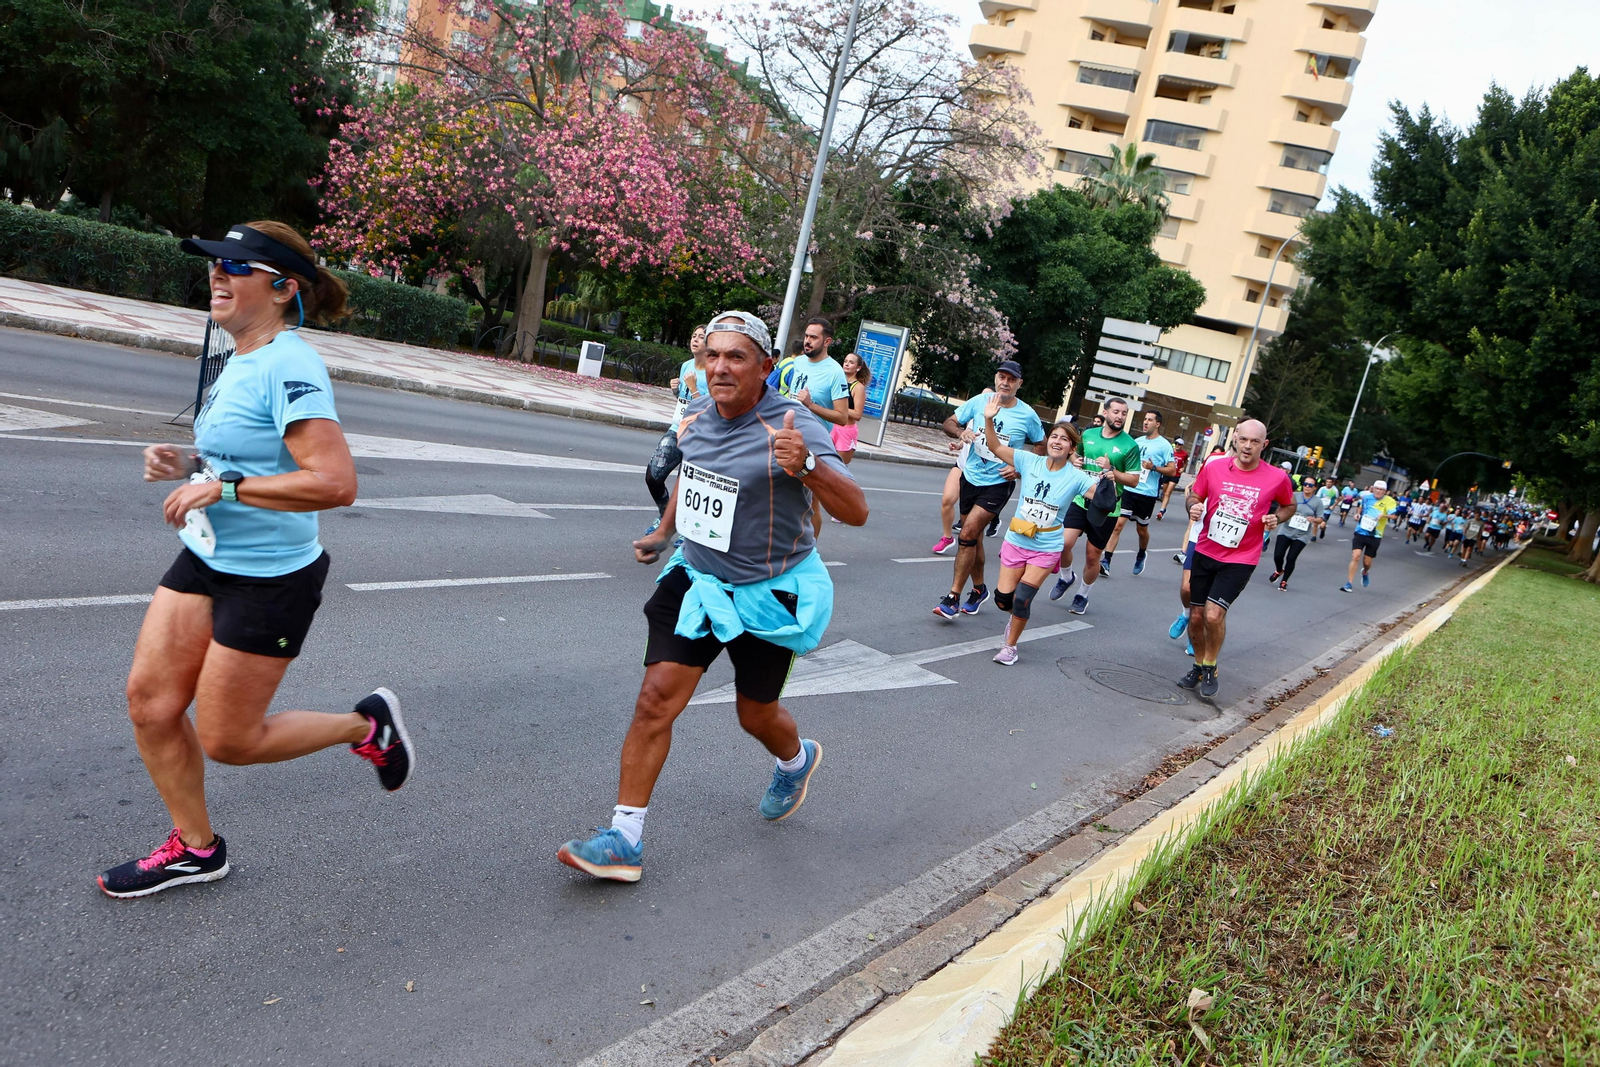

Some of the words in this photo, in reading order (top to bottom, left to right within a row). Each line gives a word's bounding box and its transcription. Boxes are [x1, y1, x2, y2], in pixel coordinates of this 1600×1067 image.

[683, 463, 694, 480] 43
[685, 488, 723, 518] 6019
[1216, 521, 1239, 535] 1771
